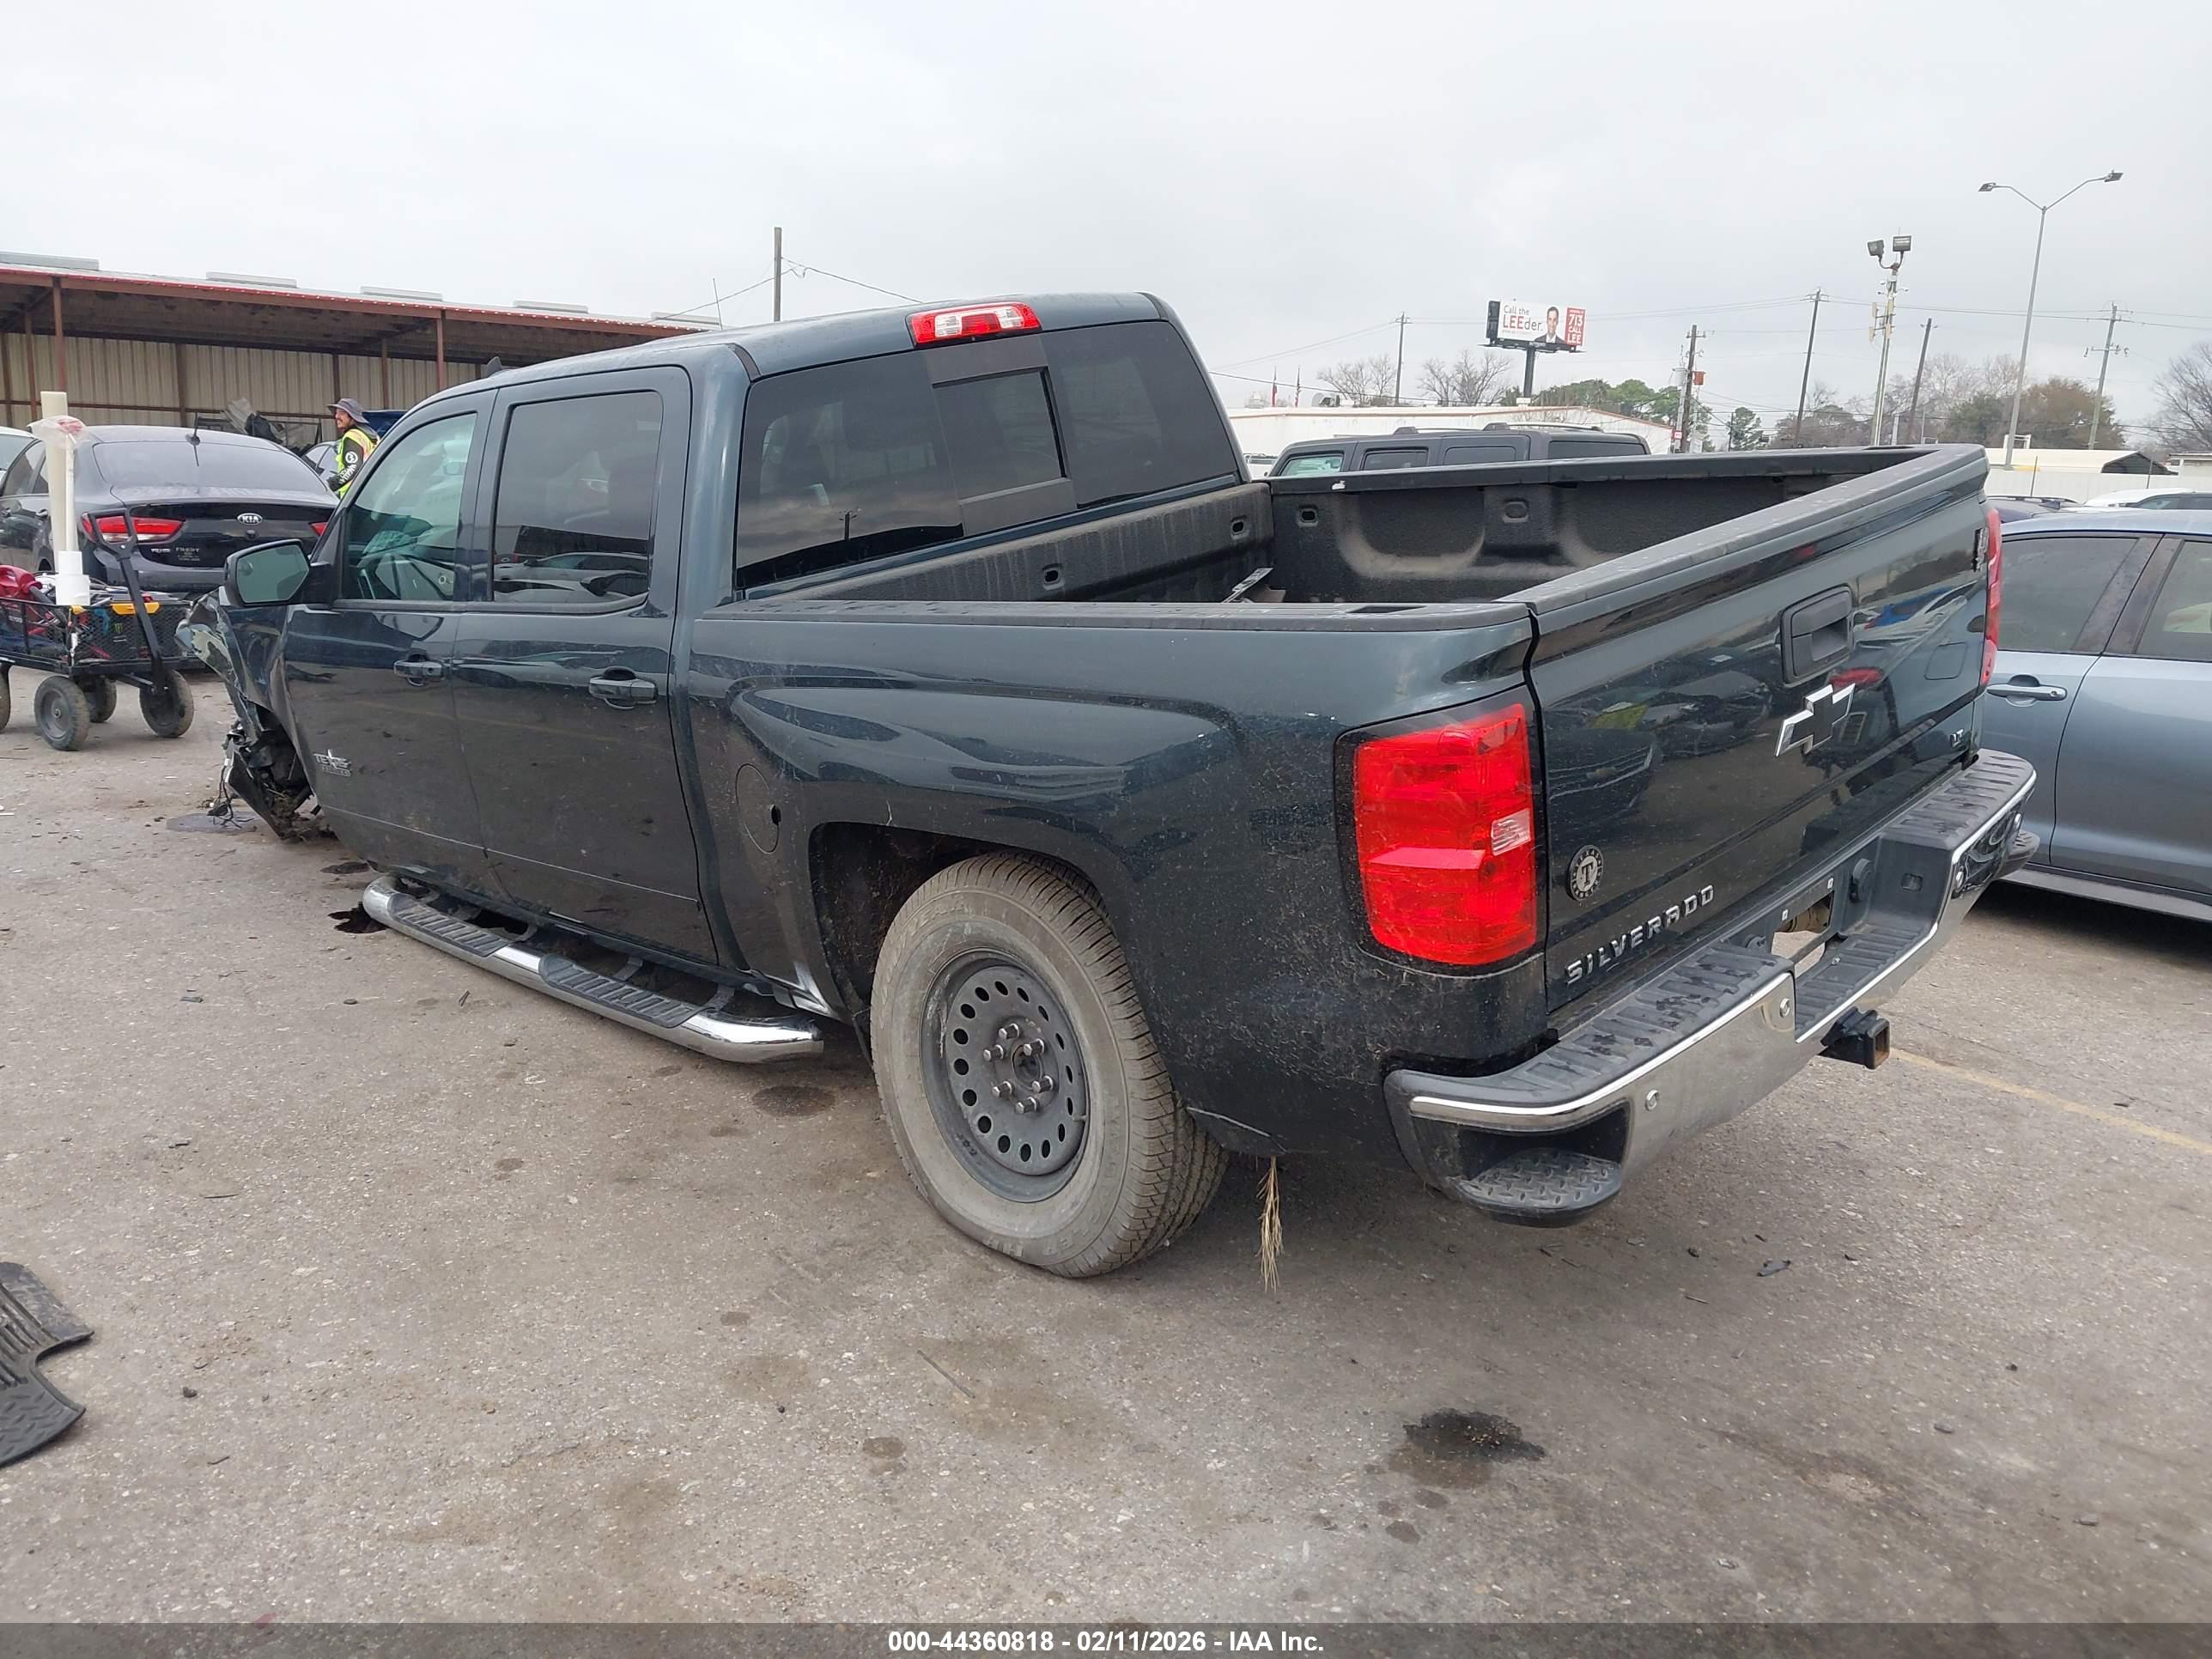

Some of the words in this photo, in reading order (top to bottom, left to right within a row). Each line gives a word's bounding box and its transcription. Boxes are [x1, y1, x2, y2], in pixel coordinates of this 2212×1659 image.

[1504, 304, 1517, 314] Call
[1518, 307, 1530, 316] the
[1568, 313, 1583, 326] 713
[1567, 333, 1582, 344] LEE
[240, 514, 259, 524] KIA
[1565, 884, 1715, 986] SILVERADO
